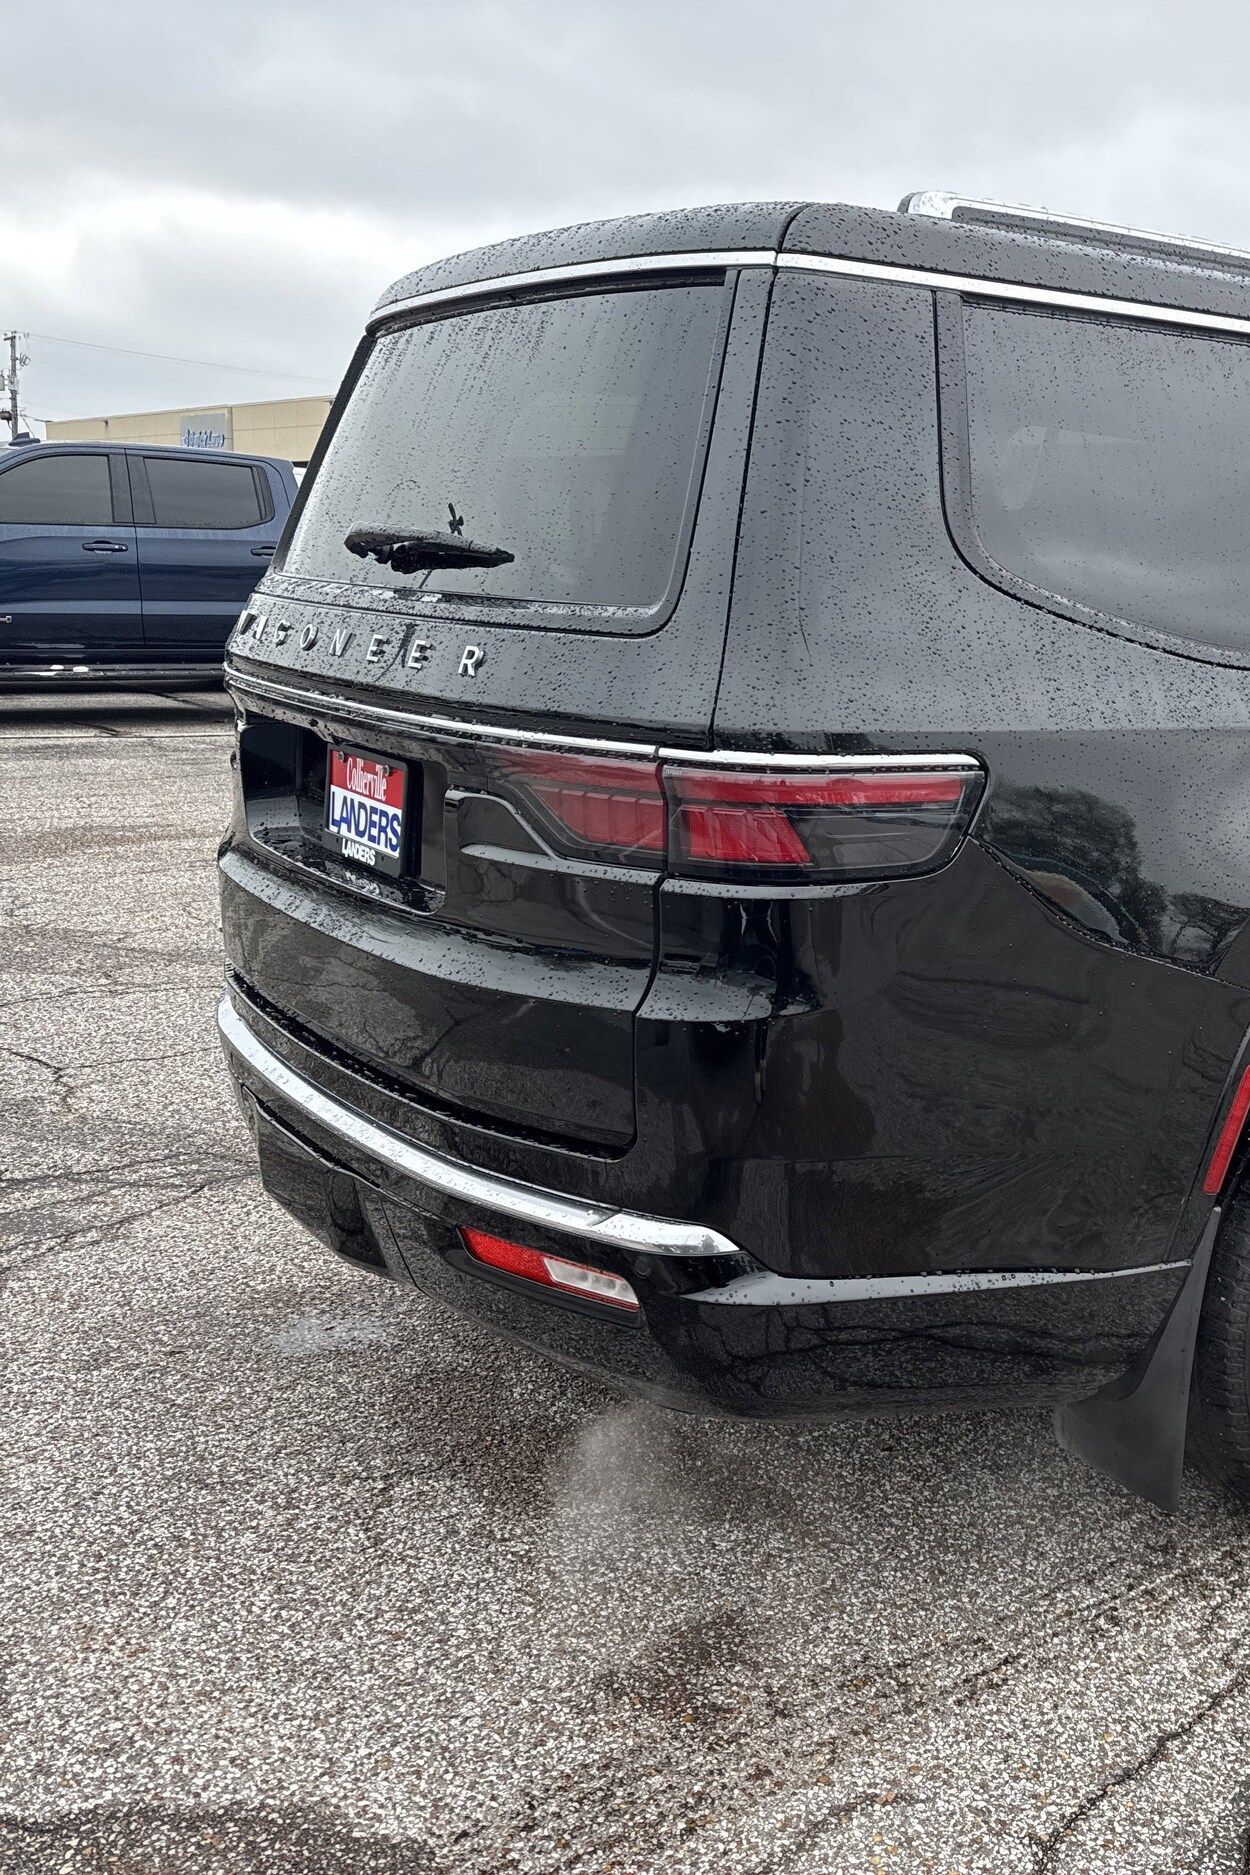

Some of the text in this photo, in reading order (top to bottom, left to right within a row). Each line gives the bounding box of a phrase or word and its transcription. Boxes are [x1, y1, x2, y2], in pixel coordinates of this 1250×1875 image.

[346, 757, 387, 801] Collierville
[331, 791, 400, 853] LANDERS
[342, 838, 376, 866] LANDERS
